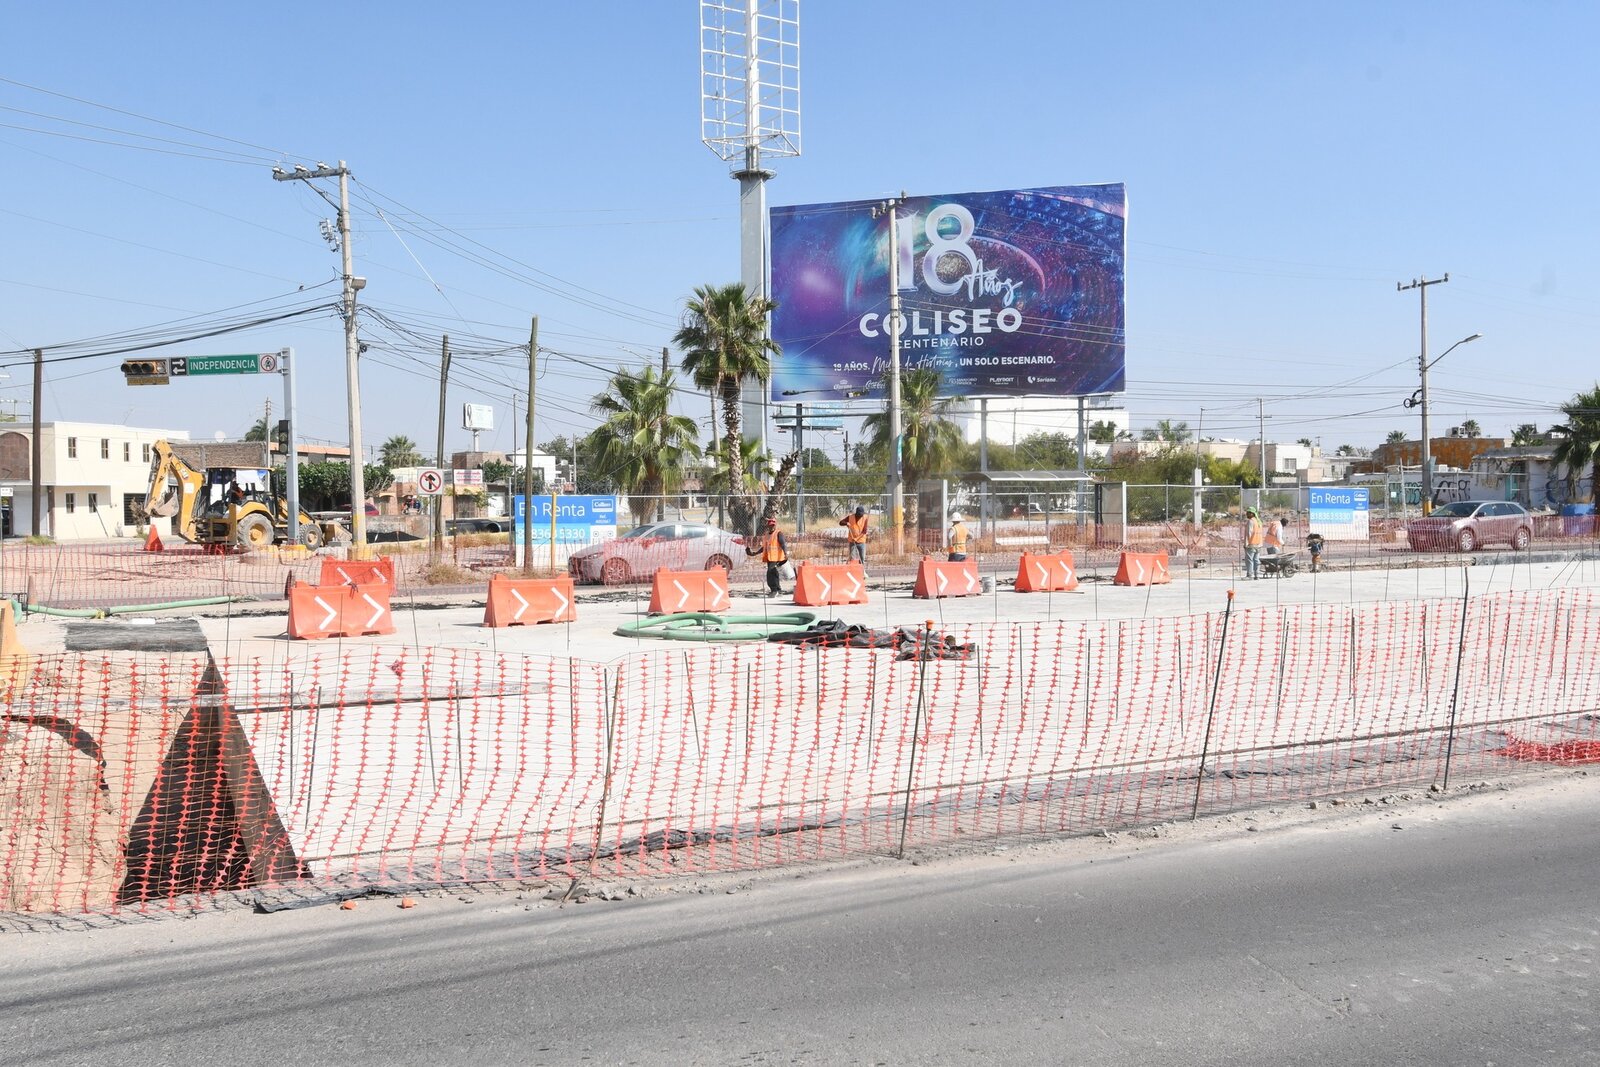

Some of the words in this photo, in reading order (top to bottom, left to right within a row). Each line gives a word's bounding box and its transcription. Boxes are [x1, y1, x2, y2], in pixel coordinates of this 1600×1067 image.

[895, 203, 976, 296] 18
[962, 259, 1023, 306] Años
[859, 308, 1022, 338] COLISEO
[190, 359, 256, 371] INDEPENDENCIA
[960, 357, 972, 366] UN
[975, 357, 999, 366] SOLO
[1002, 355, 1056, 365] ESCENARIO.
[1311, 493, 1323, 503] En
[1325, 493, 1351, 504] Renta
[519, 502, 538, 517] En
[542, 502, 586, 517] Renta
[517, 528, 586, 539] 88365330
